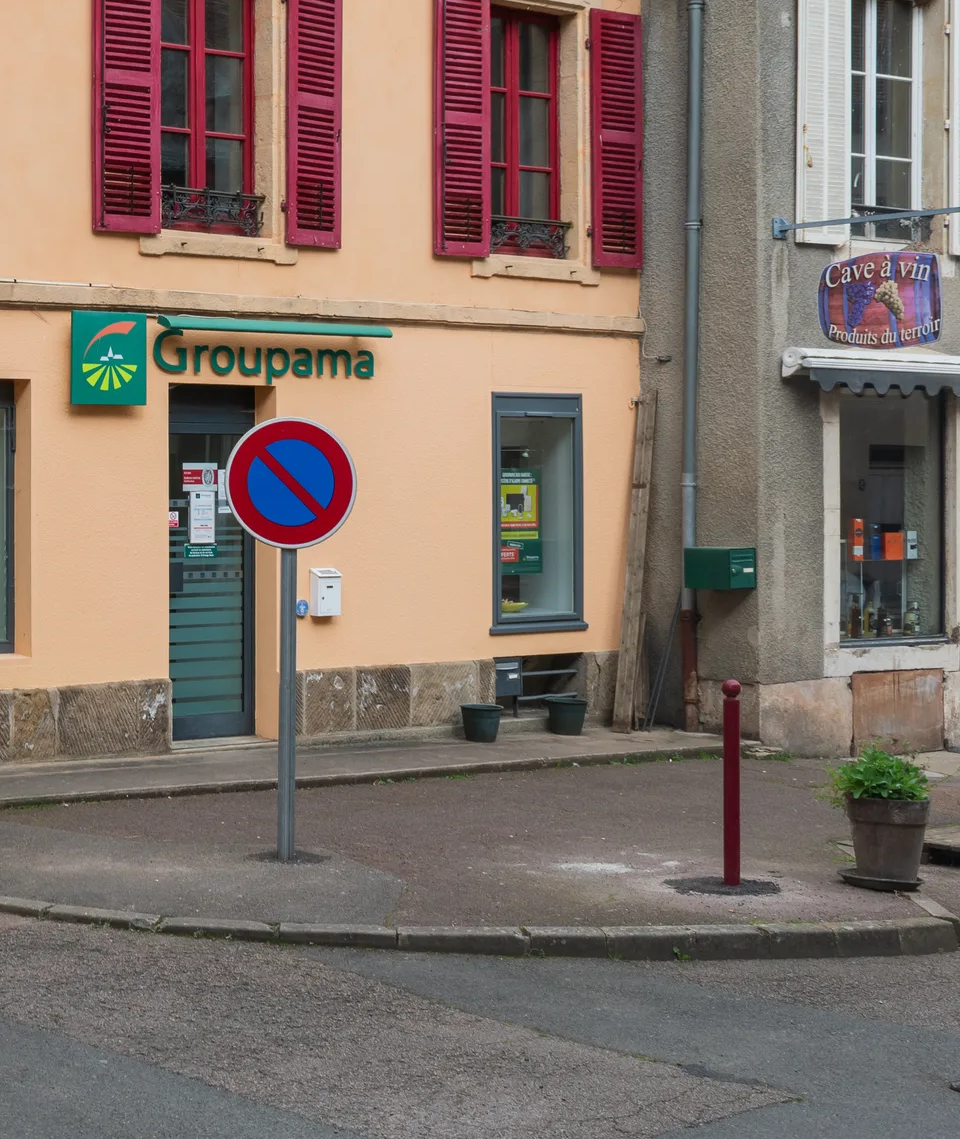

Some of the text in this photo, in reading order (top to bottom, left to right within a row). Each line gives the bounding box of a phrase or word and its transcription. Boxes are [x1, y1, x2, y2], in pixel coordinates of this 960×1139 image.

[825, 254, 931, 288] Cave à vin
[828, 316, 941, 345] Produits du terroir
[153, 328, 374, 385] Groupama
